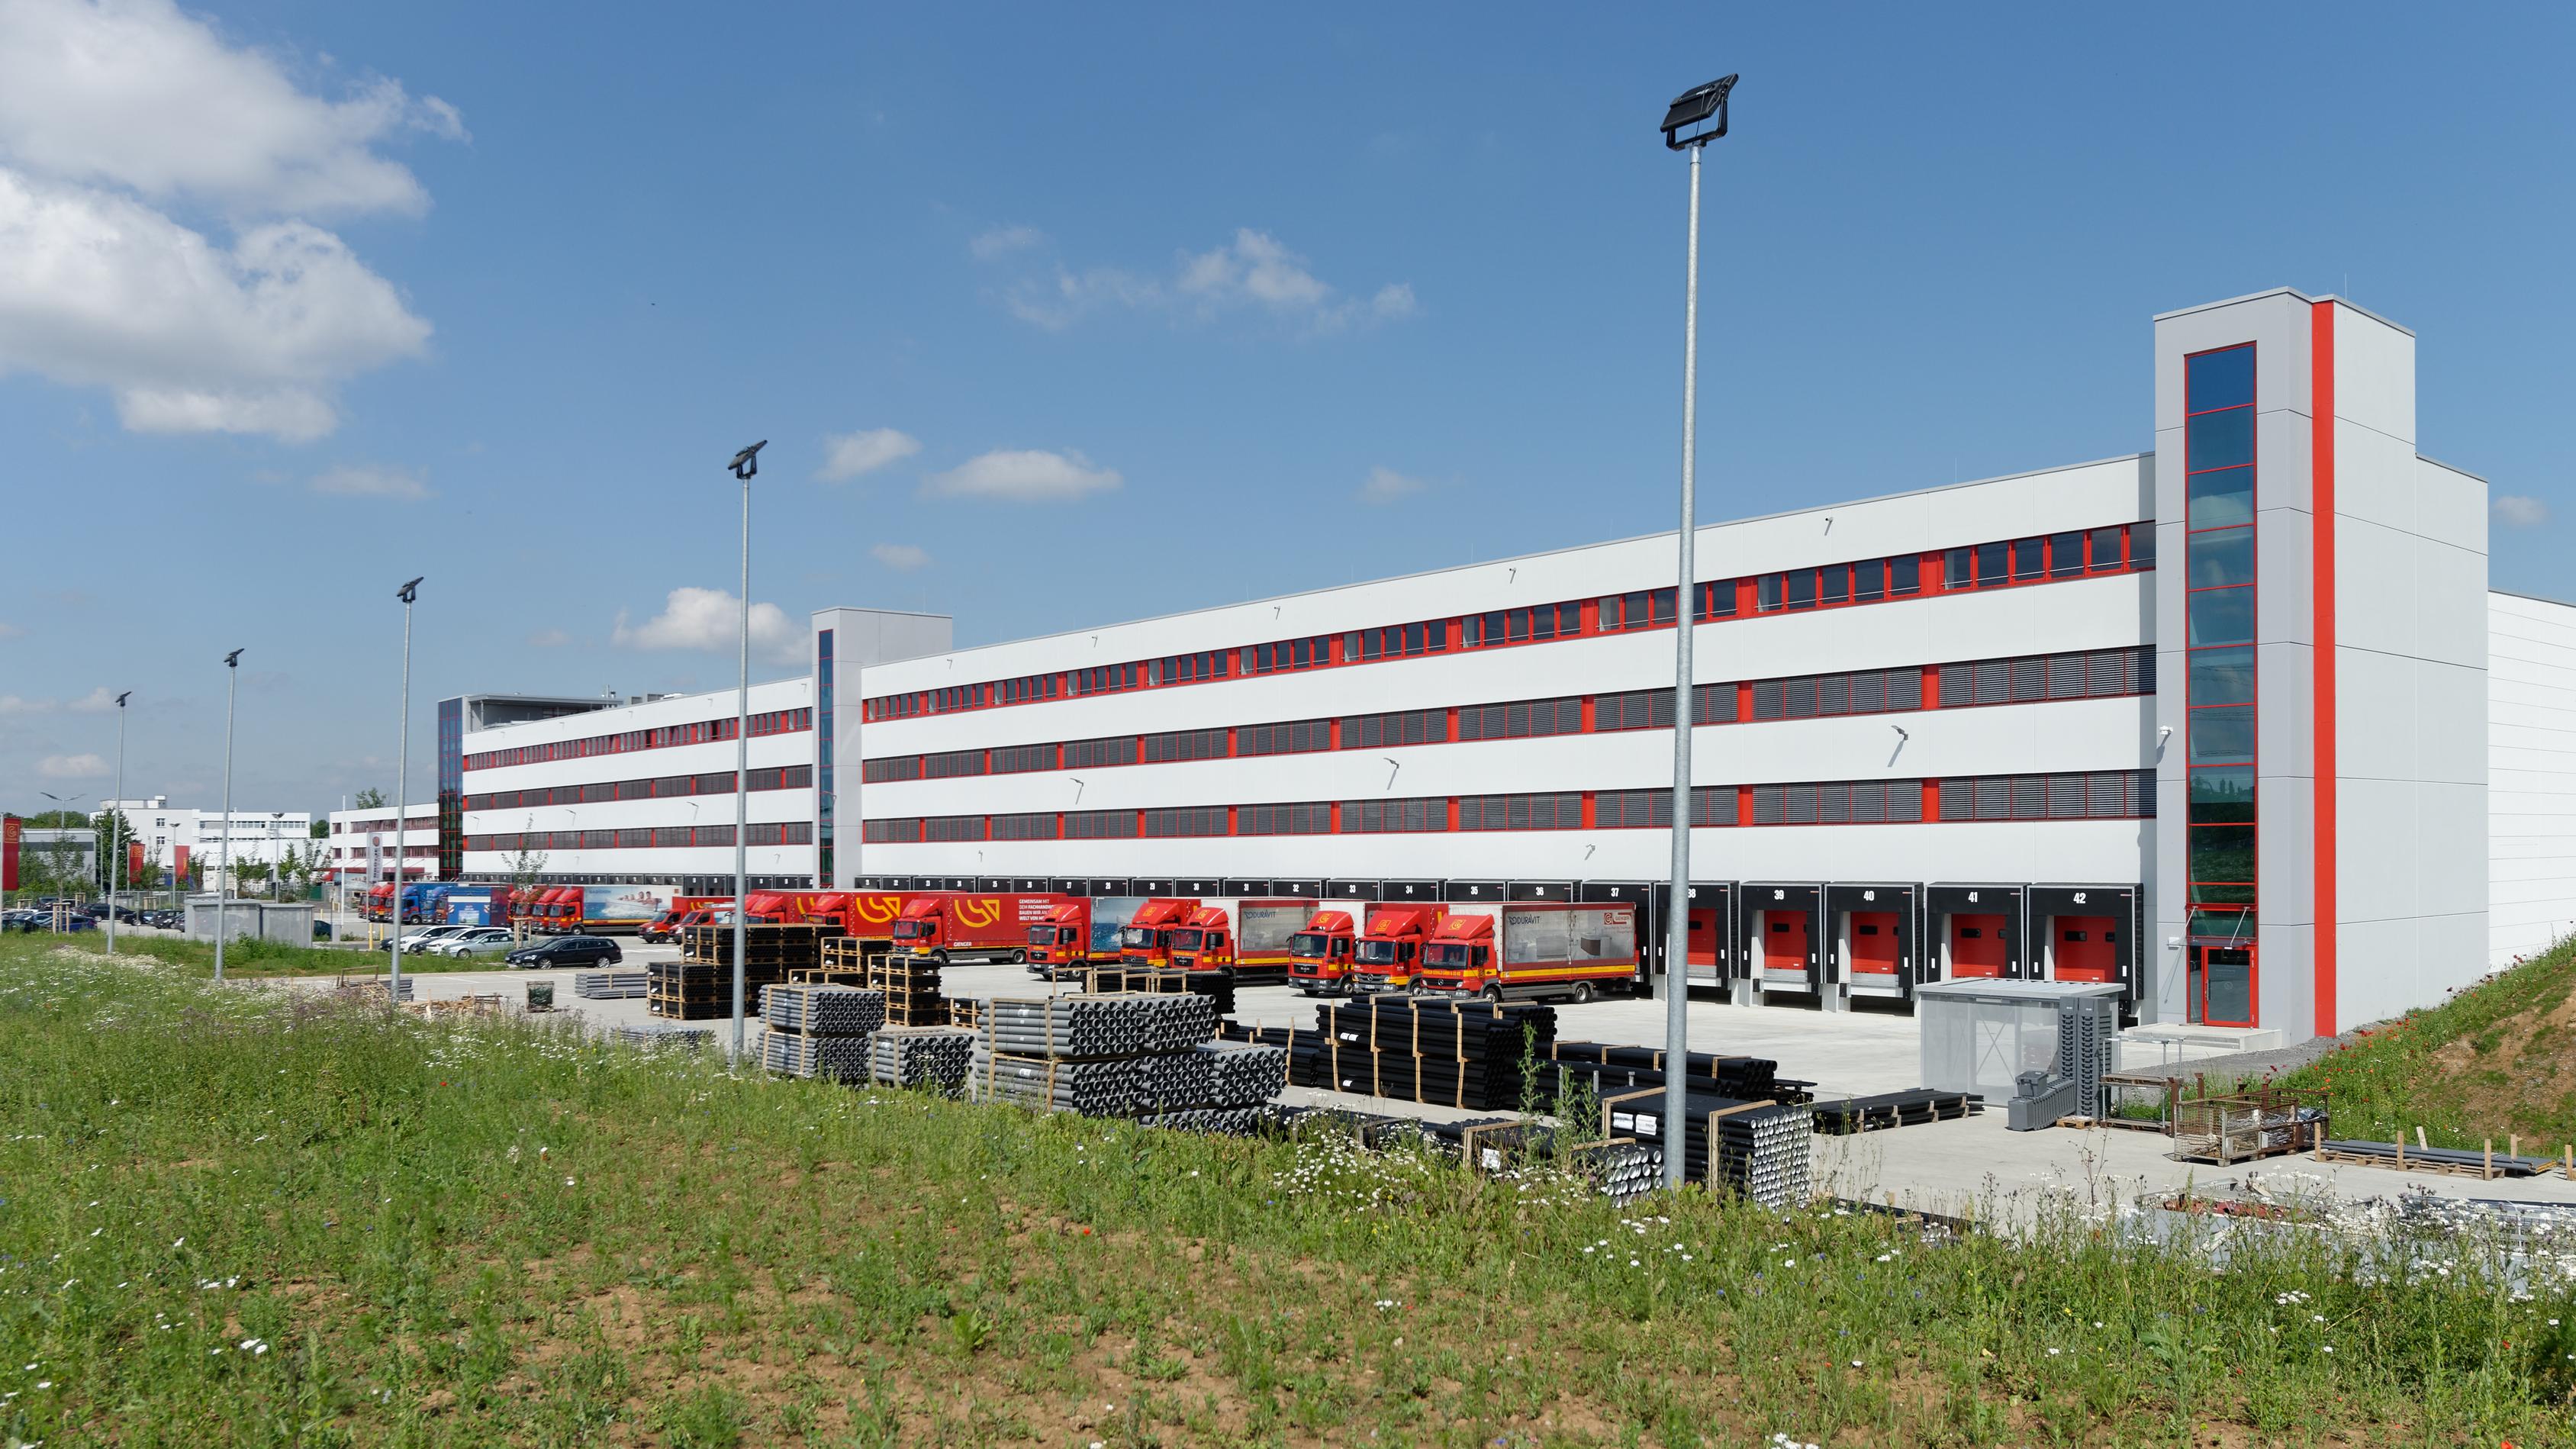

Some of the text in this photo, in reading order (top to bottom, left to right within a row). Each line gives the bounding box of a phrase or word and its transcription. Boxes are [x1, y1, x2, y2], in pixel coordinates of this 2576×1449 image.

[1293, 884, 1299, 892] 32
[1349, 884, 1356, 893] 33
[1406, 885, 1412, 894] 34
[1470, 886, 1478, 895] 35
[1536, 887, 1544, 896] 36
[1611, 887, 1619, 897] 37
[1688, 888, 1696, 898] 38
[1774, 890, 1785, 900] 39
[1863, 890, 1875, 901] 40
[1968, 891, 1978, 903] 41
[2073, 892, 2086, 903] 42
[1517, 914, 1540, 924] DURAVIT
